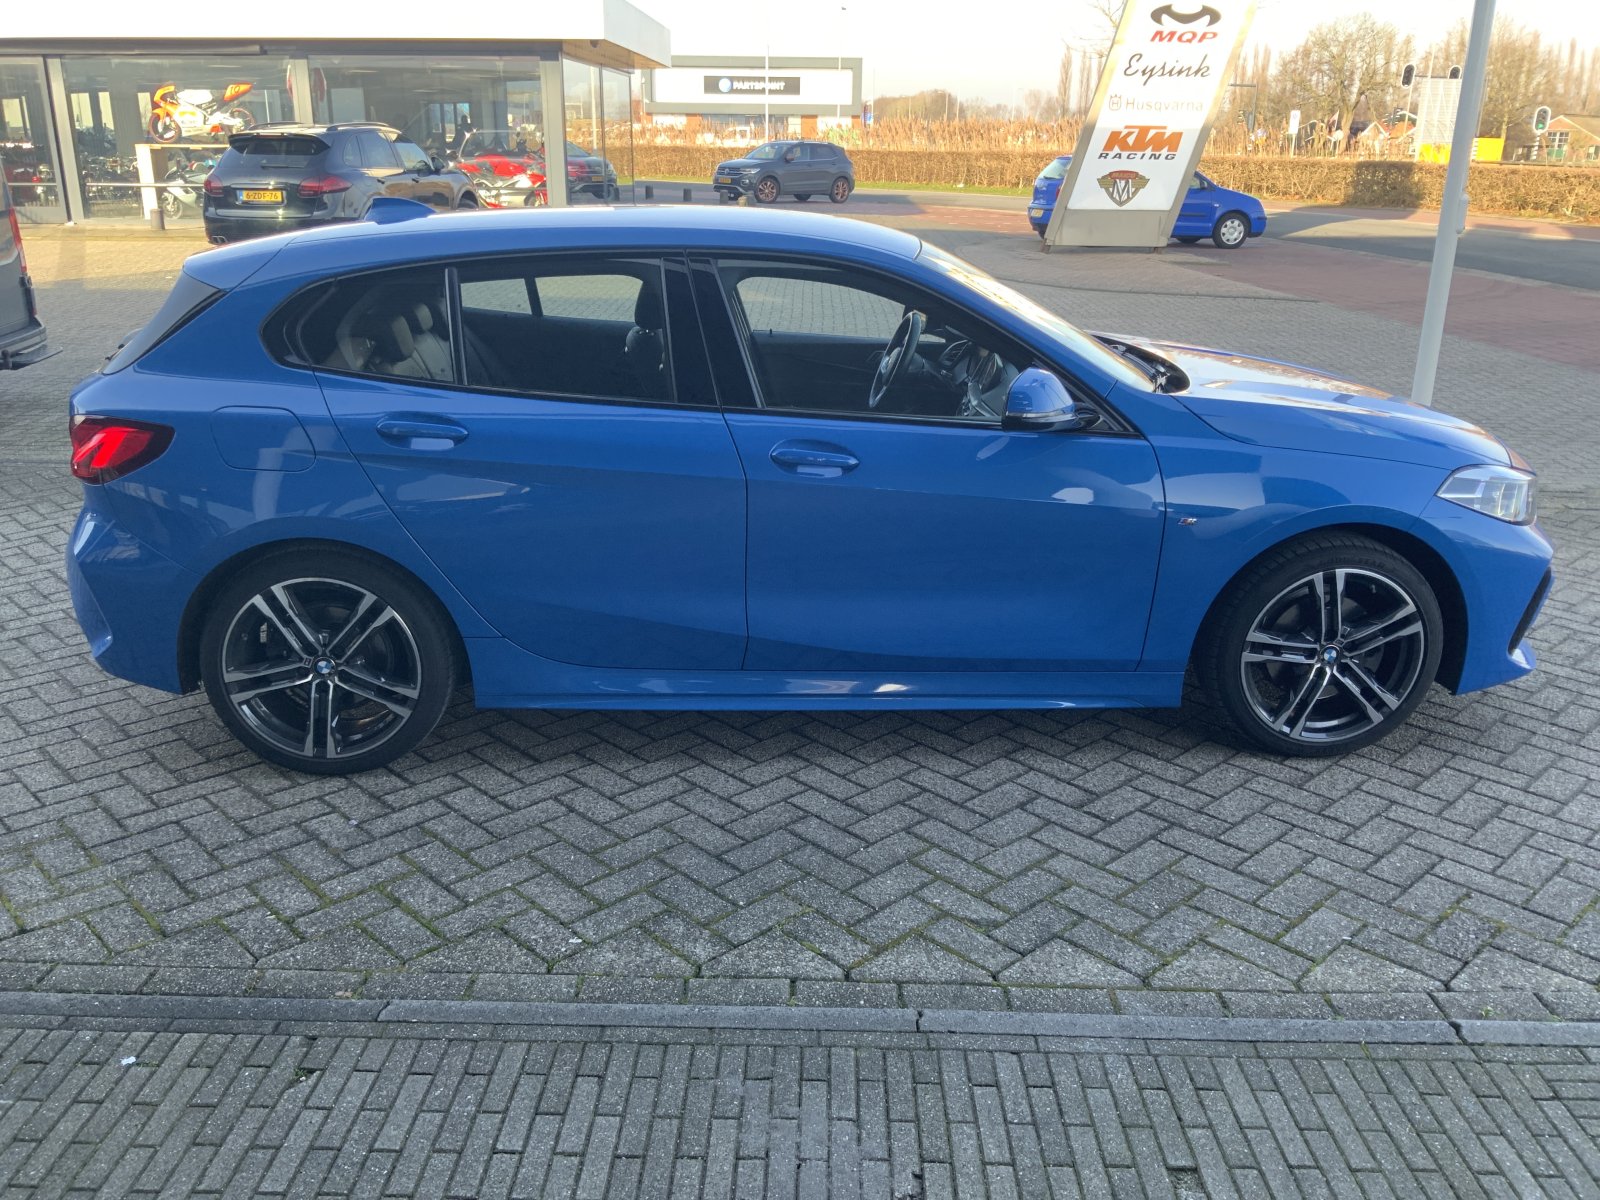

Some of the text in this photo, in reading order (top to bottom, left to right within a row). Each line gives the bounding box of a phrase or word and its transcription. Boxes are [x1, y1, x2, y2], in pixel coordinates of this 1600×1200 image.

[1150, 30, 1218, 44] MQP
[1123, 53, 1211, 86] Eysink
[1125, 97, 1204, 113] Husqvarna
[1103, 125, 1184, 152] KTM
[1098, 152, 1177, 161] RACING
[245, 192, 279, 200] 6-ZDF-76
